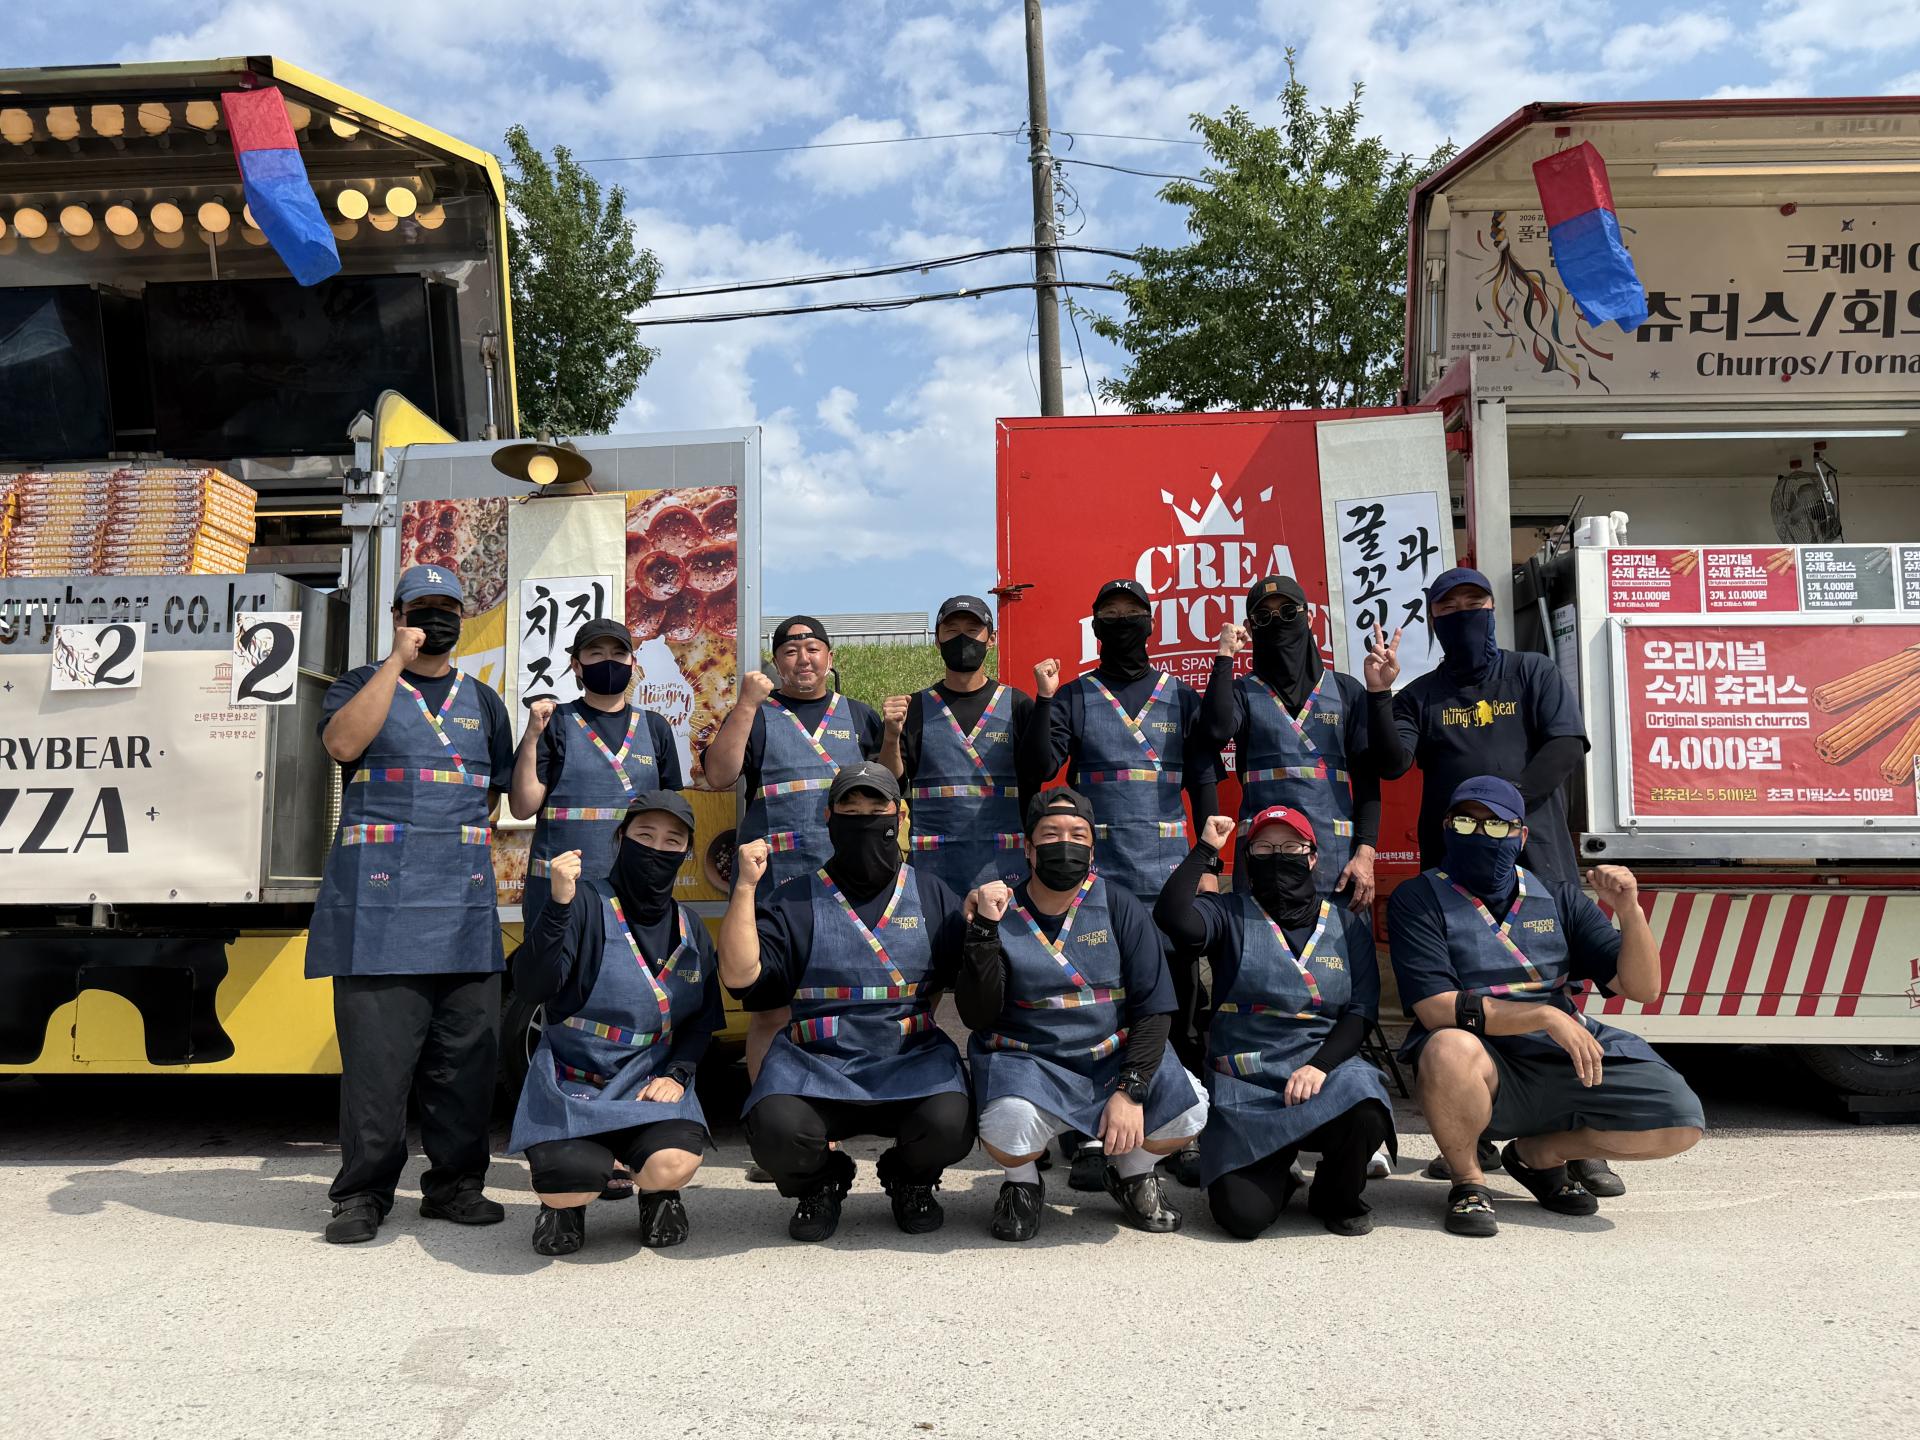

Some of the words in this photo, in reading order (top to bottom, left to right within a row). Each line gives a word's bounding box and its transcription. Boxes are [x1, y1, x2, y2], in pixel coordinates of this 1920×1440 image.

[1783, 242, 1896, 274] 크레아
[1135, 541, 1297, 595] CREA
[1611, 554, 1657, 566] 오리지널
[1707, 553, 1752, 566] 오리지널
[1805, 551, 1834, 561] 오레오
[1806, 562, 1825, 572] 수제
[1827, 561, 1856, 572] 츄러스
[427, 568, 442, 583] LA
[1612, 567, 1634, 579] 수제
[1637, 567, 1671, 579] 츄러스
[1708, 566, 1731, 578] 수제
[1733, 566, 1767, 578] 츄러스
[93, 624, 137, 686] 2
[237, 621, 295, 703] 2
[1643, 640, 1767, 671] 오리지널
[639, 684, 691, 713] Hungry
[1645, 675, 1707, 705] 수제
[1714, 674, 1809, 706] 츄러스
[1442, 705, 1479, 728] Hungry
[1493, 699, 1518, 716] Bear
[1648, 713, 1698, 728] Original
[1701, 714, 1752, 728] spanish
[1755, 714, 1808, 727] churros
[0, 735, 153, 770] RYBEAR
[1648, 736, 1783, 770] 4,000원
[1651, 787, 1703, 801] 컵츄러스
[1767, 788, 1794, 802] 초코
[1854, 787, 1894, 802] 500원
